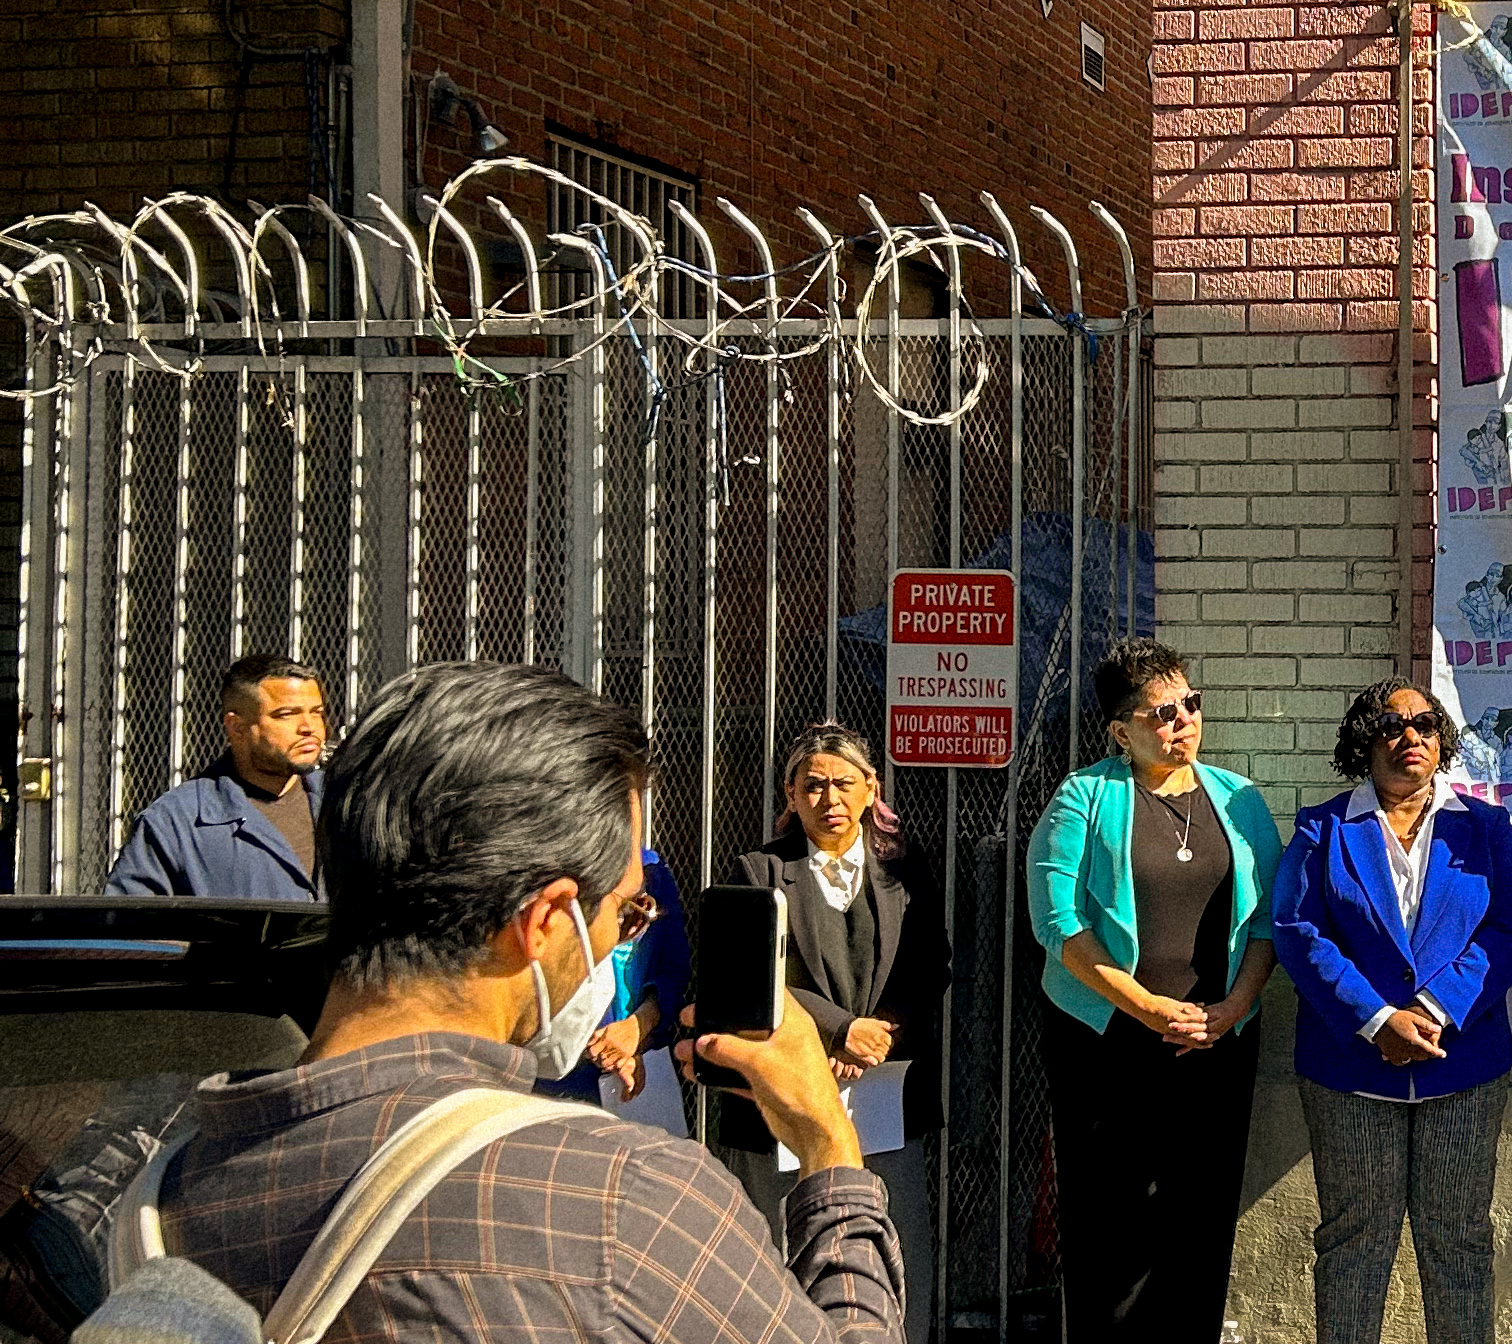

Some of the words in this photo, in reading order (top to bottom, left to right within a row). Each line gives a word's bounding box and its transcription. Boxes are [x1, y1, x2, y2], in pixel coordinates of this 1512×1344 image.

[911, 584, 996, 606] PRIVATE
[899, 611, 1007, 634] PROPERTY
[937, 652, 968, 672] NO
[898, 677, 1007, 698] TRESPASSING
[895, 714, 970, 733] VIOLATORS
[975, 716, 1008, 734] WILL
[896, 736, 913, 754] BE
[919, 736, 1007, 756] PROSECUTED
